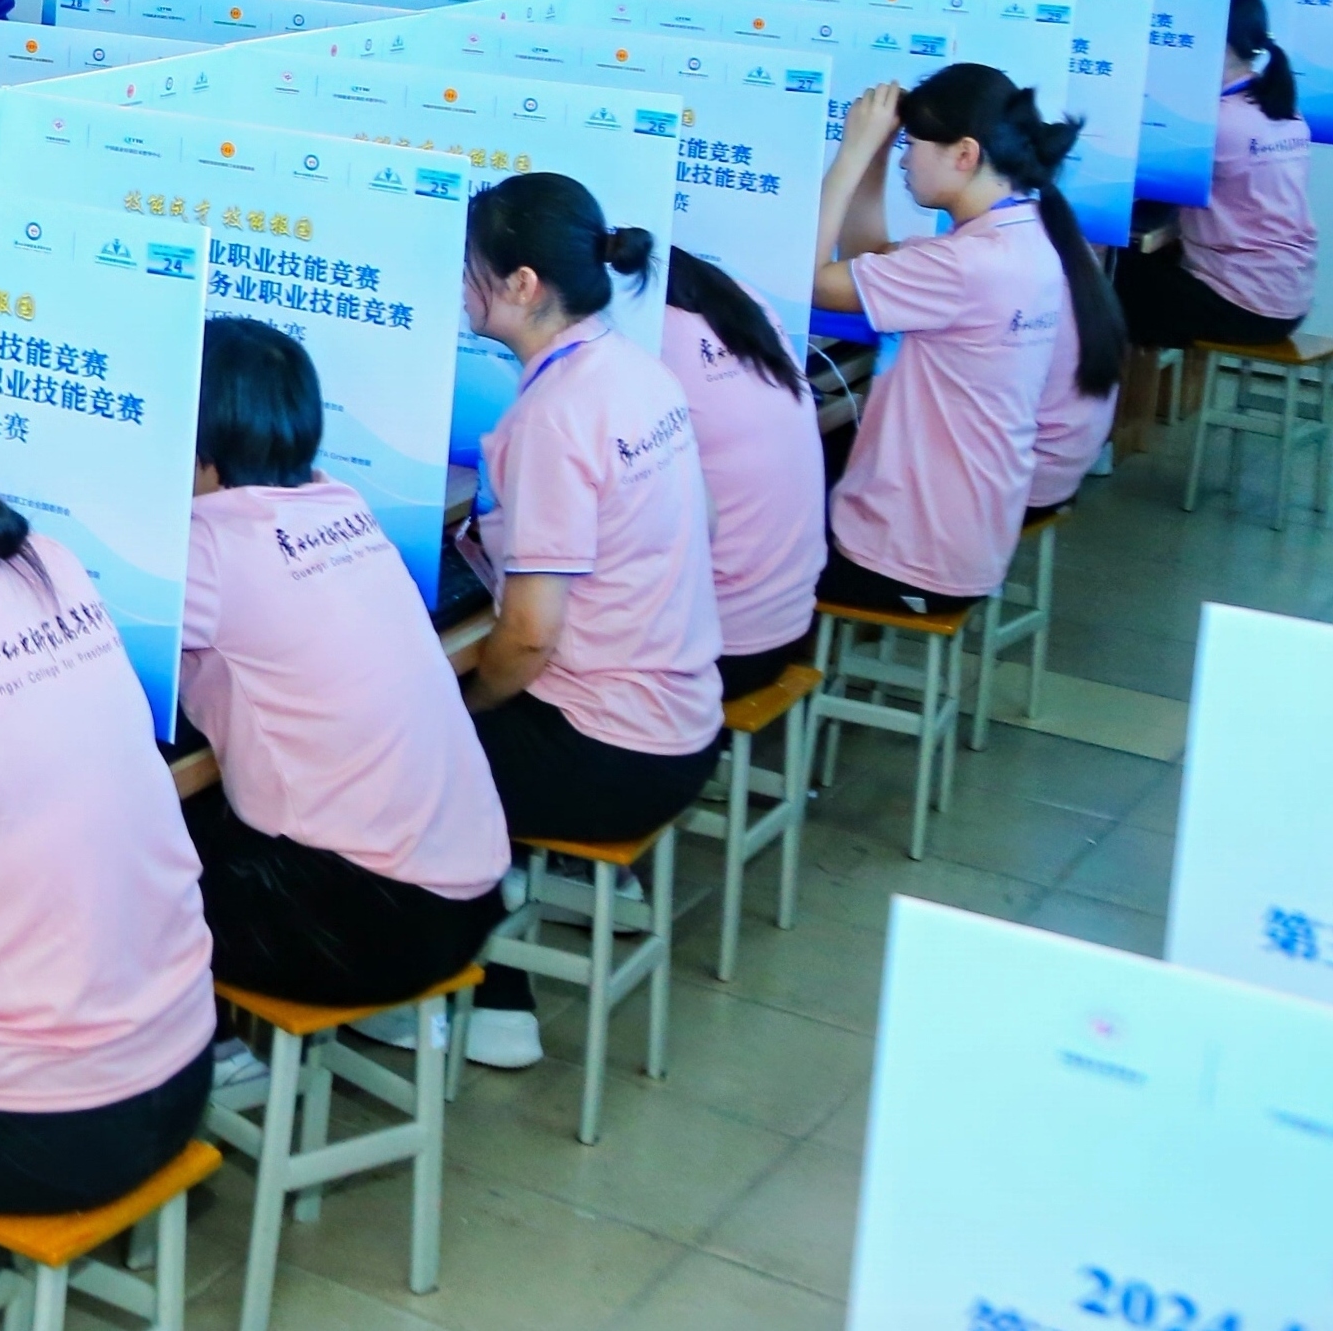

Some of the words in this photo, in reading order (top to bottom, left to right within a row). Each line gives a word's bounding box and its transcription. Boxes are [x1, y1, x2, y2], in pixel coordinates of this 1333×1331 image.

[798, 78, 814, 91] 27
[647, 119, 668, 135] 26
[430, 181, 450, 197] 25
[162, 257, 184, 275] 24
[209, 238, 381, 293] 业职业技能竞赛
[207, 270, 415, 331] 务业职业技能竞赛
[28, 664, 61, 684] College
[1077, 1261, 1235, 1331] 202
